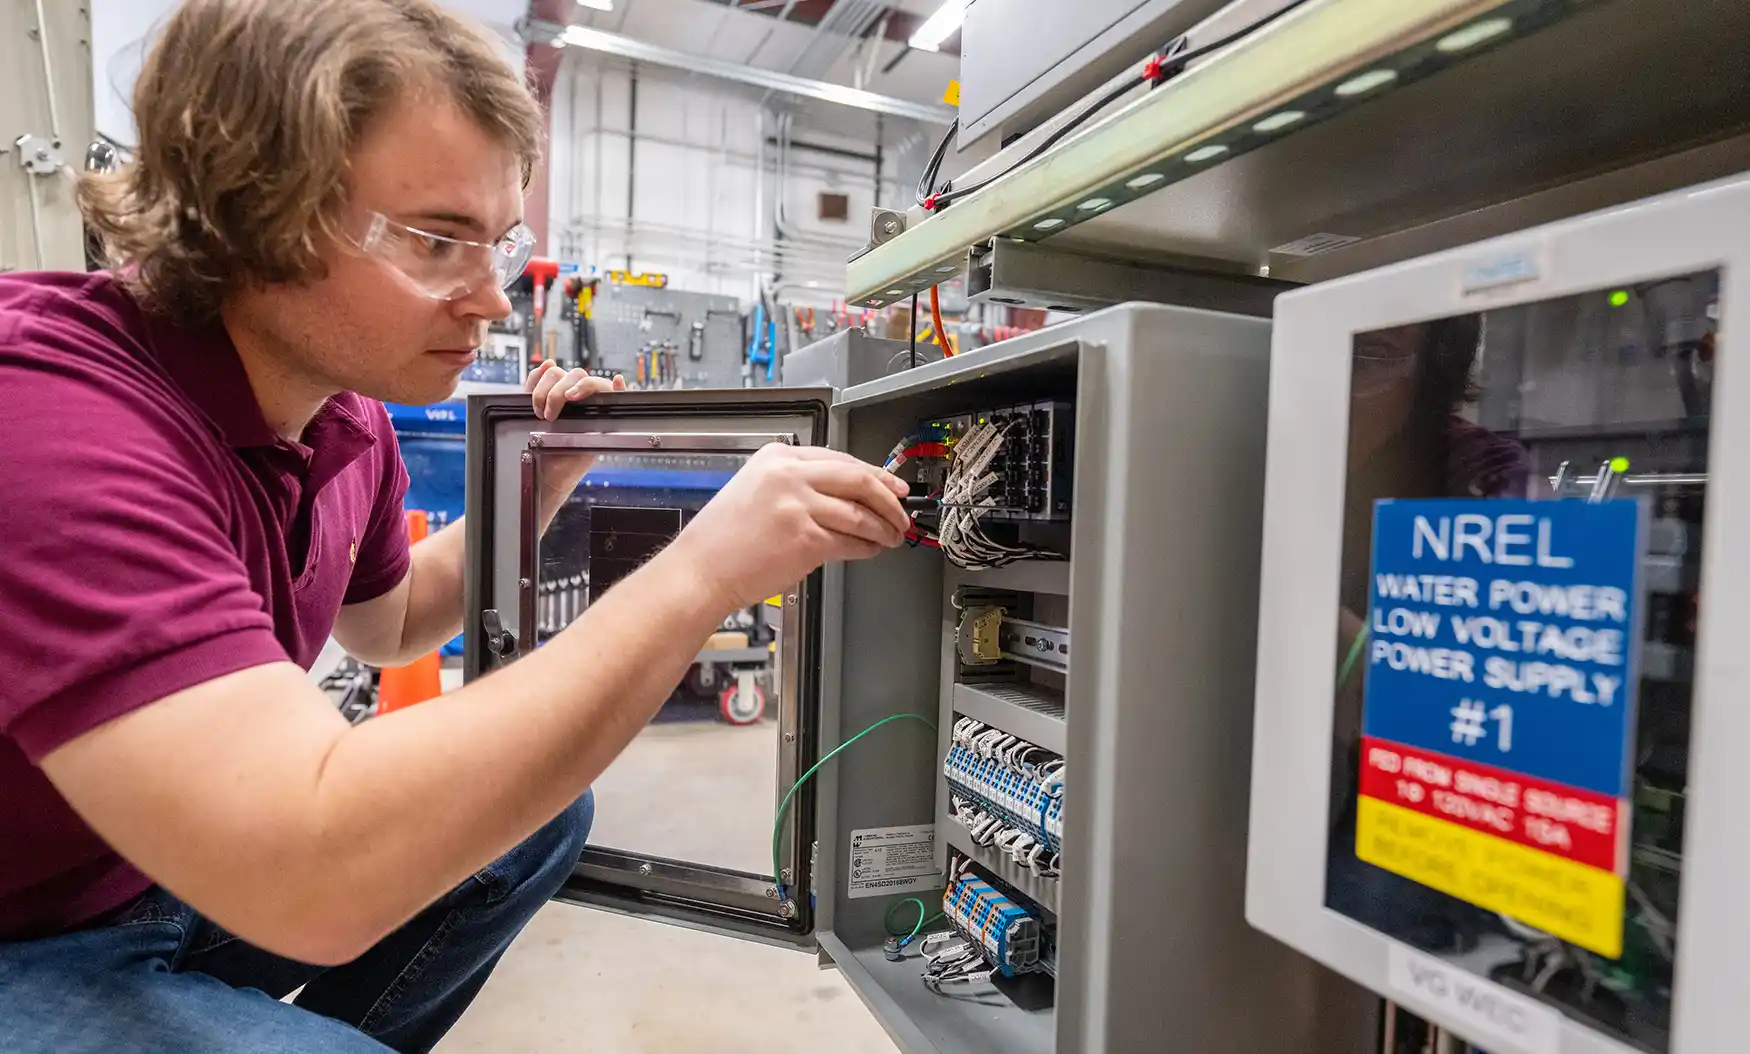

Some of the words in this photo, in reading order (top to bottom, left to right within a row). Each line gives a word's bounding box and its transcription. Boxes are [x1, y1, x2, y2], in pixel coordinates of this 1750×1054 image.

[1412, 514, 1575, 568] NREL
[1376, 573, 1479, 609] WATER
[1489, 579, 1627, 623] POWER
[1372, 607, 1440, 639] LOW
[1451, 615, 1623, 666] VOLTAGE
[1371, 639, 1475, 683] POWER
[1483, 656, 1621, 707] SUPPLY
[1449, 697, 1514, 752] #1
[1402, 756, 1452, 787] FROM
[1453, 769, 1521, 808] SINGLE
[1523, 787, 1613, 835] SOURCE
